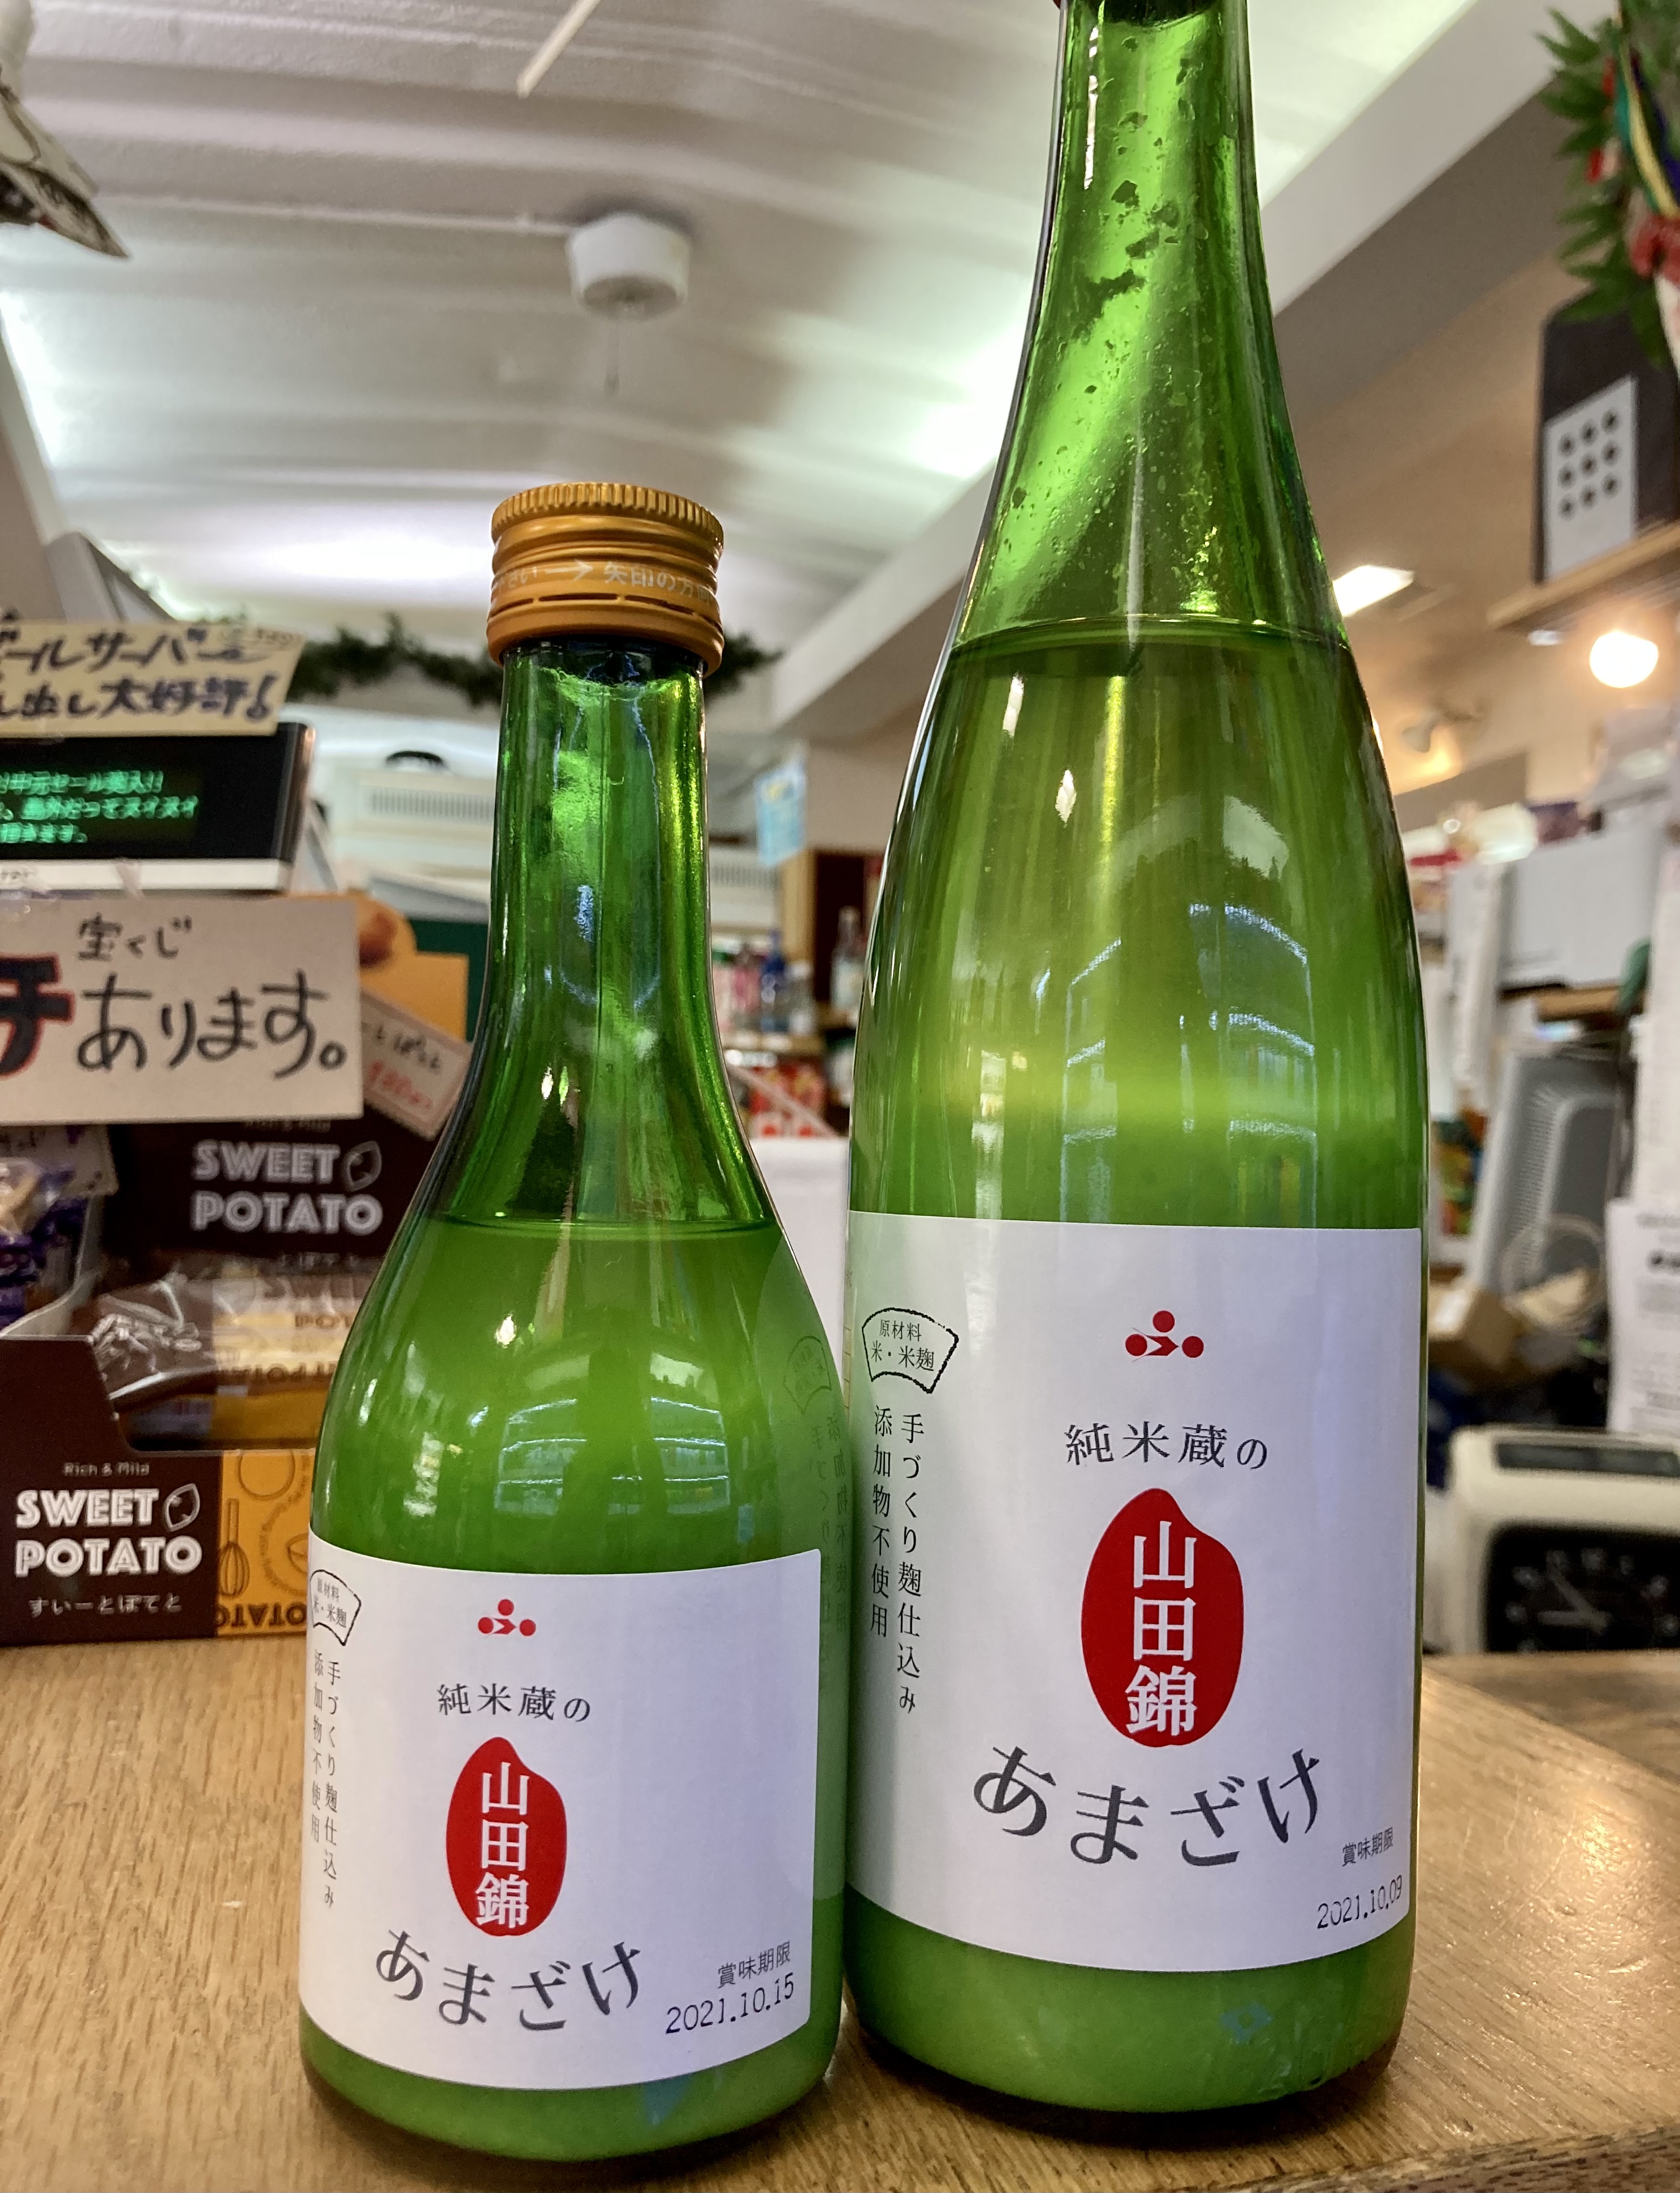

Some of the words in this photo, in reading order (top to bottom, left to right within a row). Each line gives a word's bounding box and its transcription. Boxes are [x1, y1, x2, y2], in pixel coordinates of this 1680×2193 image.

[0, 627, 253, 673] ールサーバー
[78, 912, 192, 960] 宝くじ
[192, 1139, 341, 1183] SWEET
[190, 1190, 383, 1236] POTATO
[879, 1319, 922, 1342] 原材料
[1064, 1421, 1267, 1470] 純米蔵の
[15, 1488, 159, 1528] SWEET
[871, 1405, 892, 1637] 添加物不使用
[14, 1535, 202, 1578] POTATO
[897, 1413, 924, 1714] 手づくり麹仕込み
[28, 1593, 182, 1617] すいーとぽてと
[1125, 1521, 1196, 1736] 山田錦
[437, 1683, 590, 1722] 純米蔵の
[974, 1746, 1320, 1867] あまざけ
[475, 1762, 529, 1929] 山田錦
[1342, 1826, 1393, 1867] 賞味期限
[1317, 1875, 1402, 1929] 2021.10.09
[376, 1930, 641, 2031] あまざけ
[718, 1940, 791, 1989] 賞味期限
[666, 1972, 793, 2034] 2021.10.15
